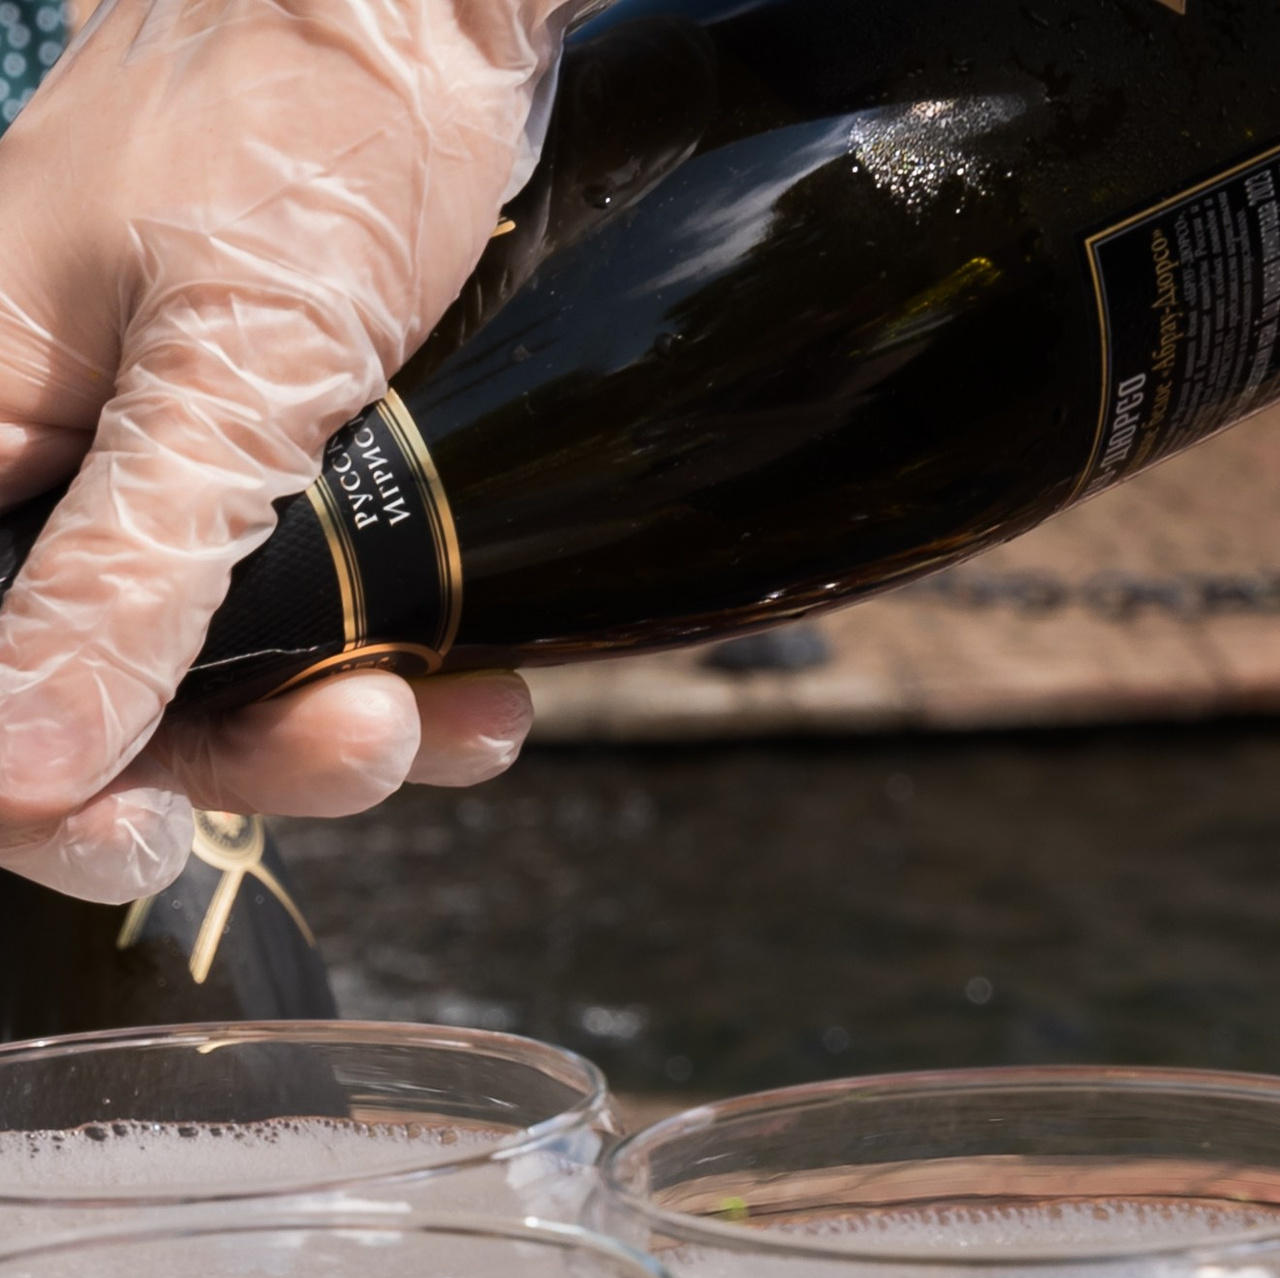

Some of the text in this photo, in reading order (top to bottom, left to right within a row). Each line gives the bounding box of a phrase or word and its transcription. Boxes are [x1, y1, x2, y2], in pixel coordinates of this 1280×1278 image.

[1244, 169, 1275, 206] 2023
[1151, 229, 1183, 378] «Абрау-Дюрсо»
[1090, 371, 1146, 489] У-ДЮРСО
